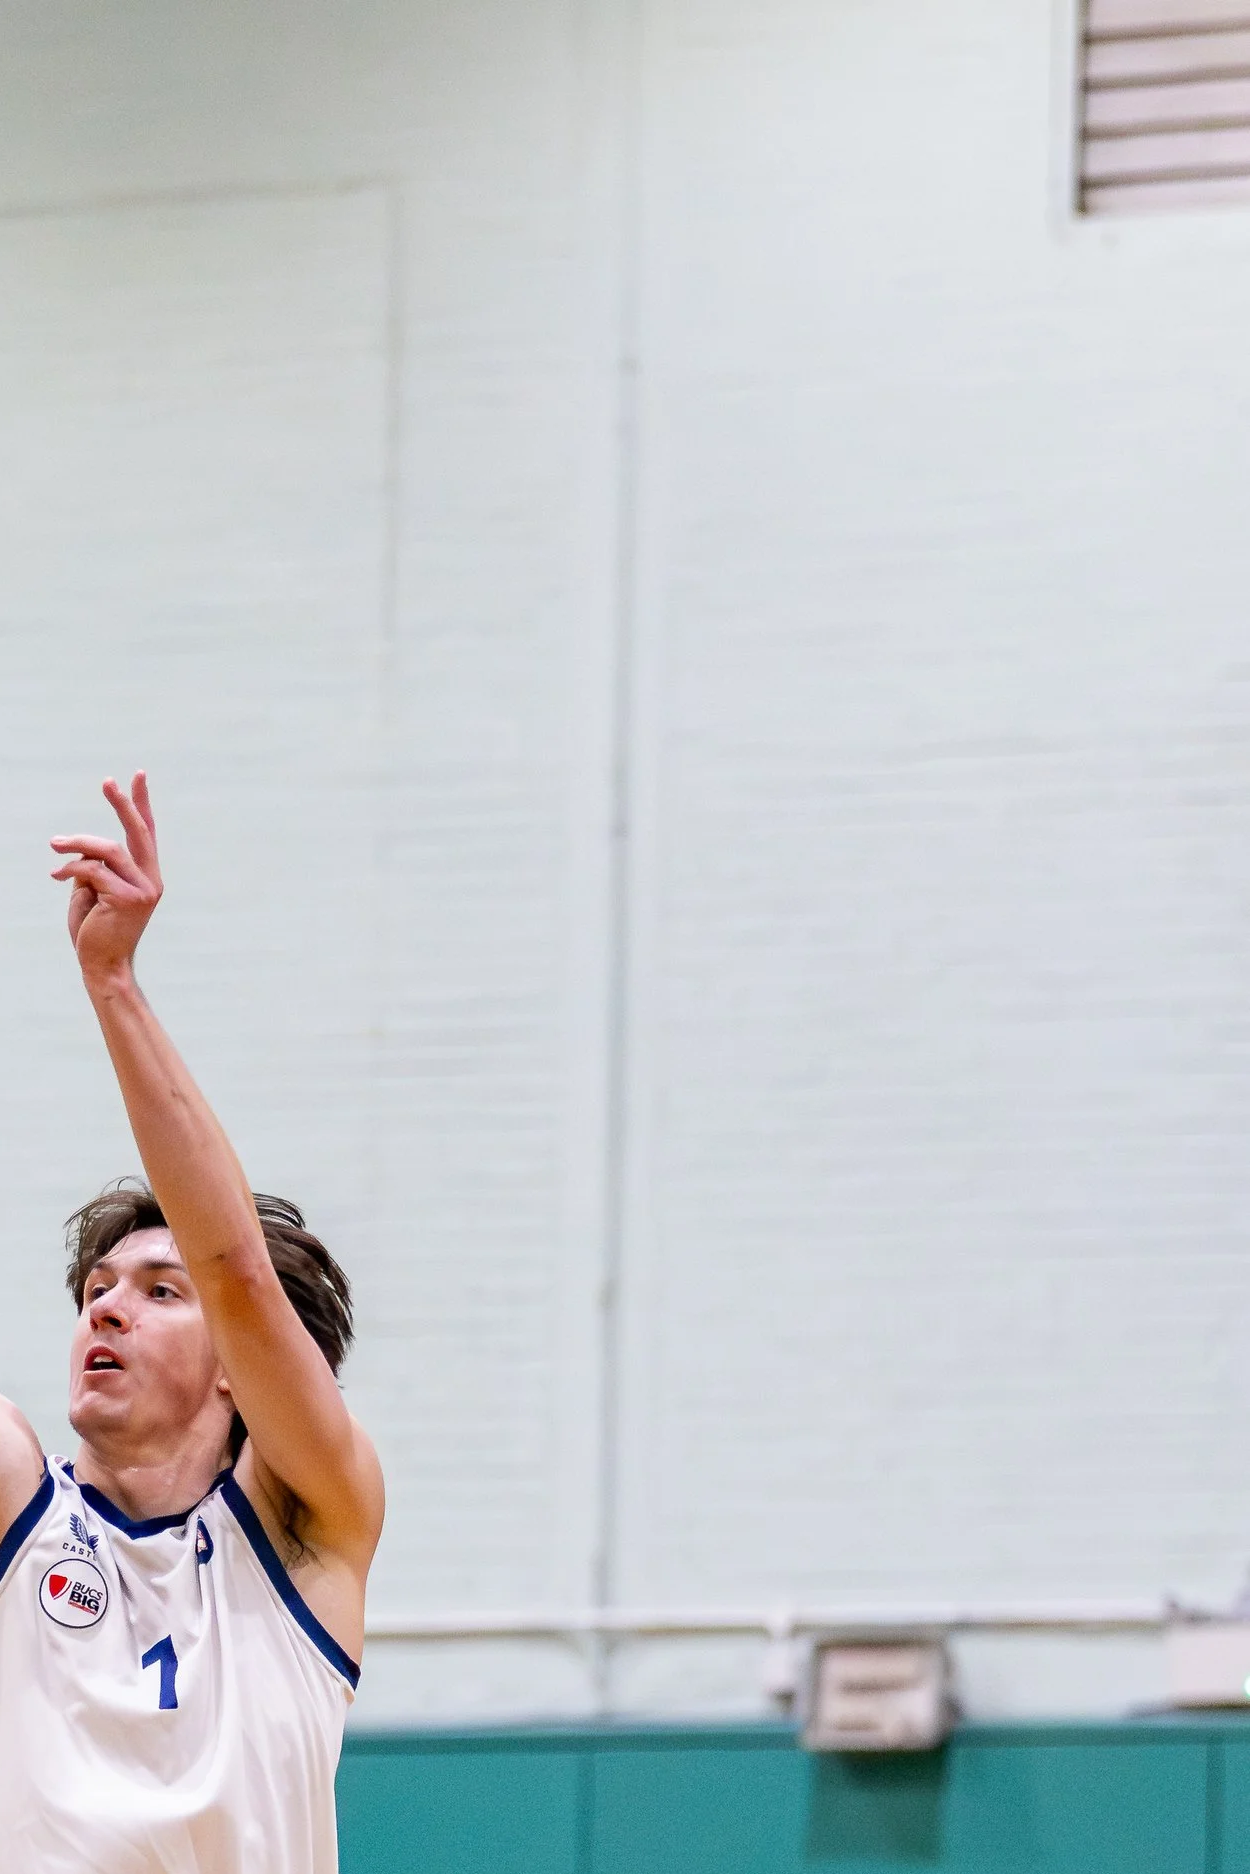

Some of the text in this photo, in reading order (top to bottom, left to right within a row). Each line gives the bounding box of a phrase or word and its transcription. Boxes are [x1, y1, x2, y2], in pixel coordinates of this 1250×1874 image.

[73, 1581, 103, 1600] BUCS
[69, 1591, 99, 1612] BIG
[142, 1634, 179, 1710] 1
